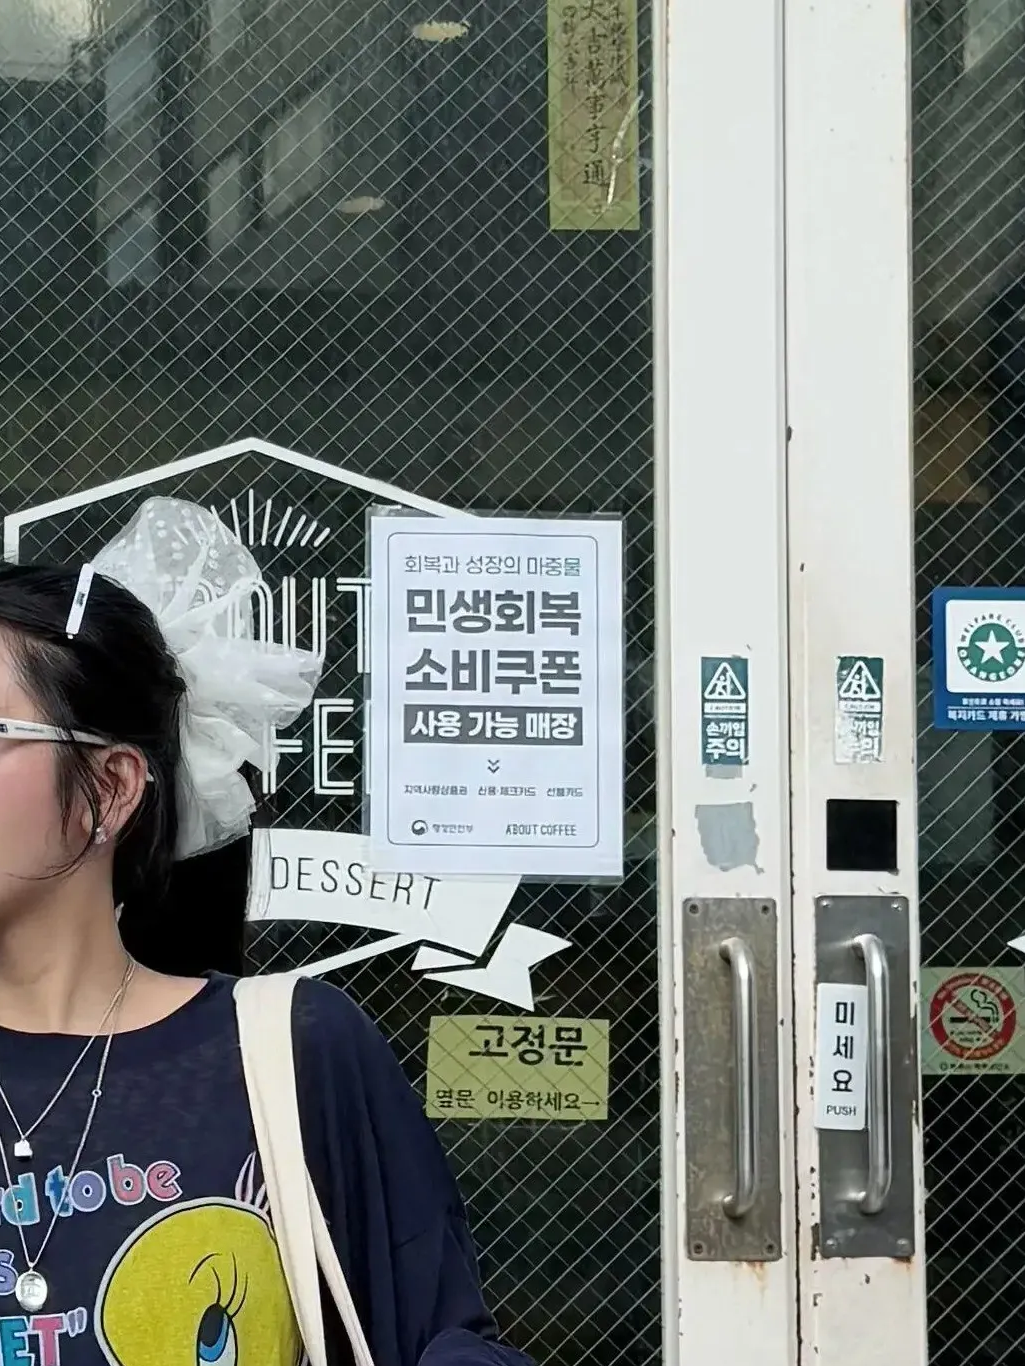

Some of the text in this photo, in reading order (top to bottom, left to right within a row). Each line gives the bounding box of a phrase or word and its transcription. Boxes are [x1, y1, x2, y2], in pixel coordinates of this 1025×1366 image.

[404, 555, 581, 577] 회복과 성장의 마중물
[406, 588, 582, 636] 민생회복
[405, 648, 582, 695] 소비쿠폰
[410, 710, 577, 740] 사용 가능 매장
[705, 721, 745, 738] 손끼임
[705, 737, 746, 761] 주의
[505, 823, 577, 837] ABOUT COFFEE
[271, 856, 442, 910] DESSERT
[468, 1025, 588, 1067] 고정문
[831, 1001, 855, 1093] 미세요
[487, 1090, 581, 1111] 이용하세요
[826, 1104, 857, 1116] PUSH
[44, 1164, 107, 1218] to
[106, 1153, 183, 1207] be
